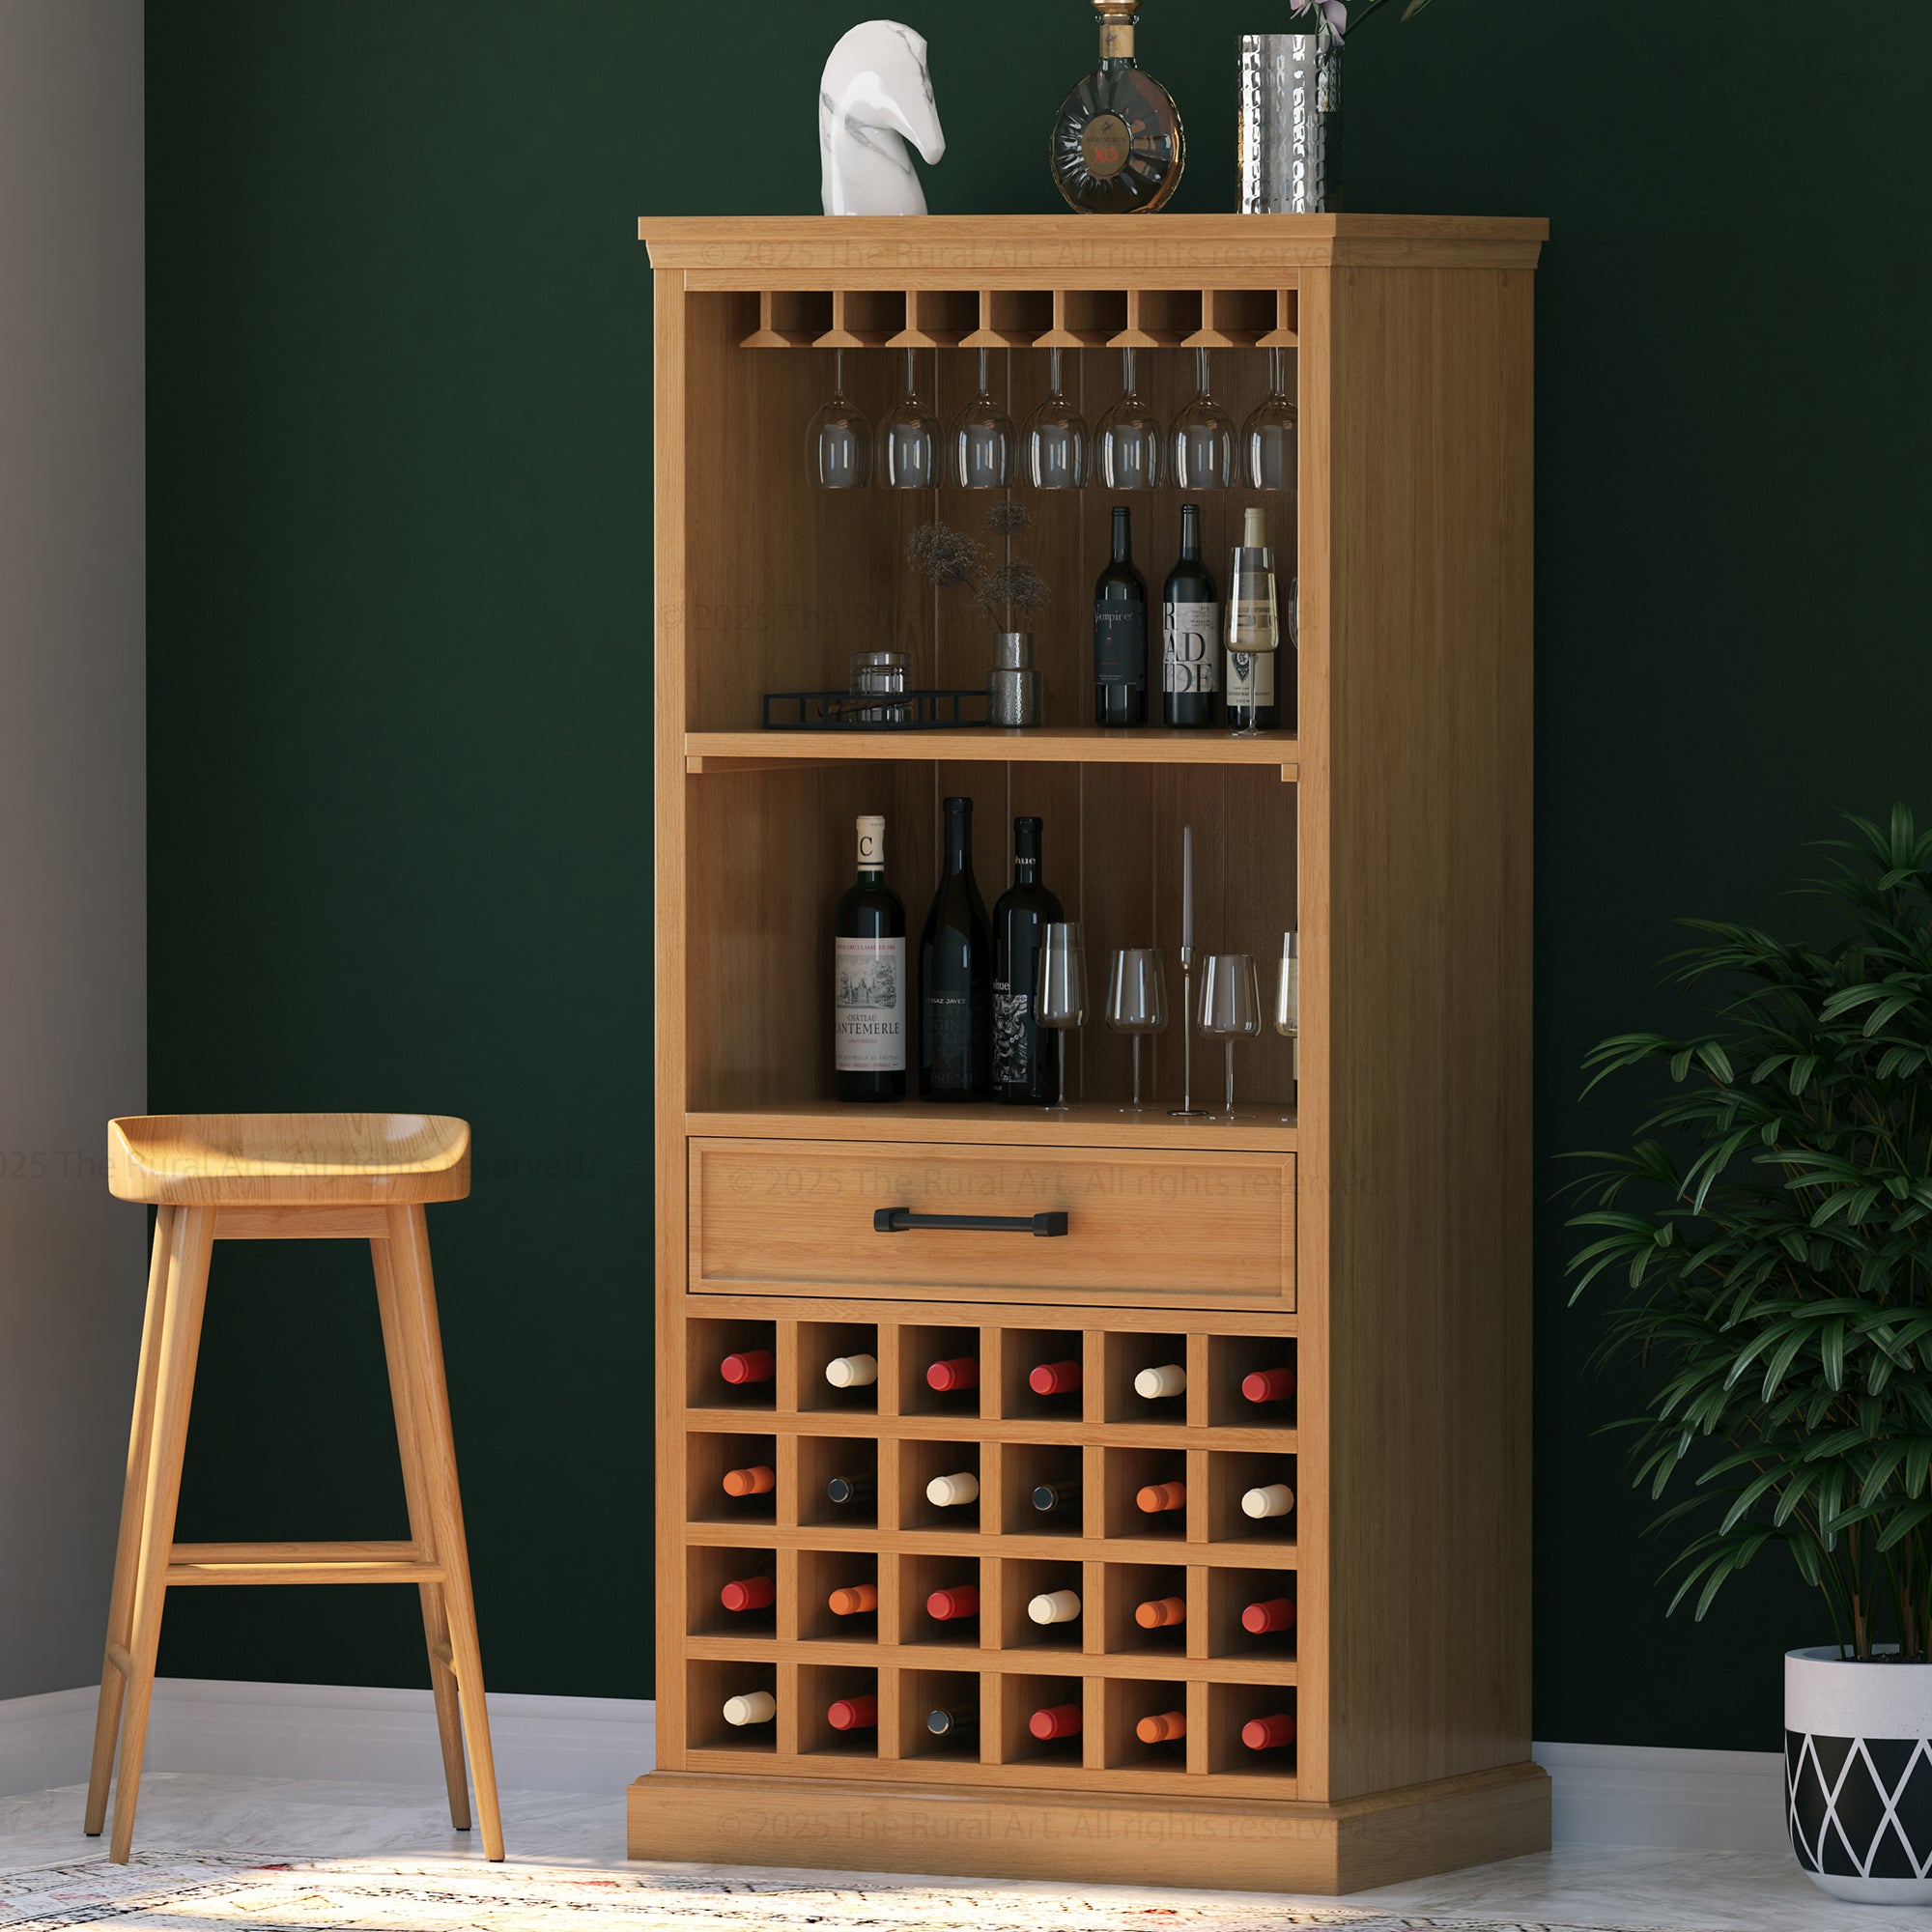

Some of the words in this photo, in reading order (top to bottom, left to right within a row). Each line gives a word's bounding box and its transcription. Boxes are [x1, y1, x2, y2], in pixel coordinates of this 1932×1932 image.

[1094, 147, 1118, 163] XO
[860, 837, 872, 856] C
[836, 1023, 899, 1035] ANTEMERLE
